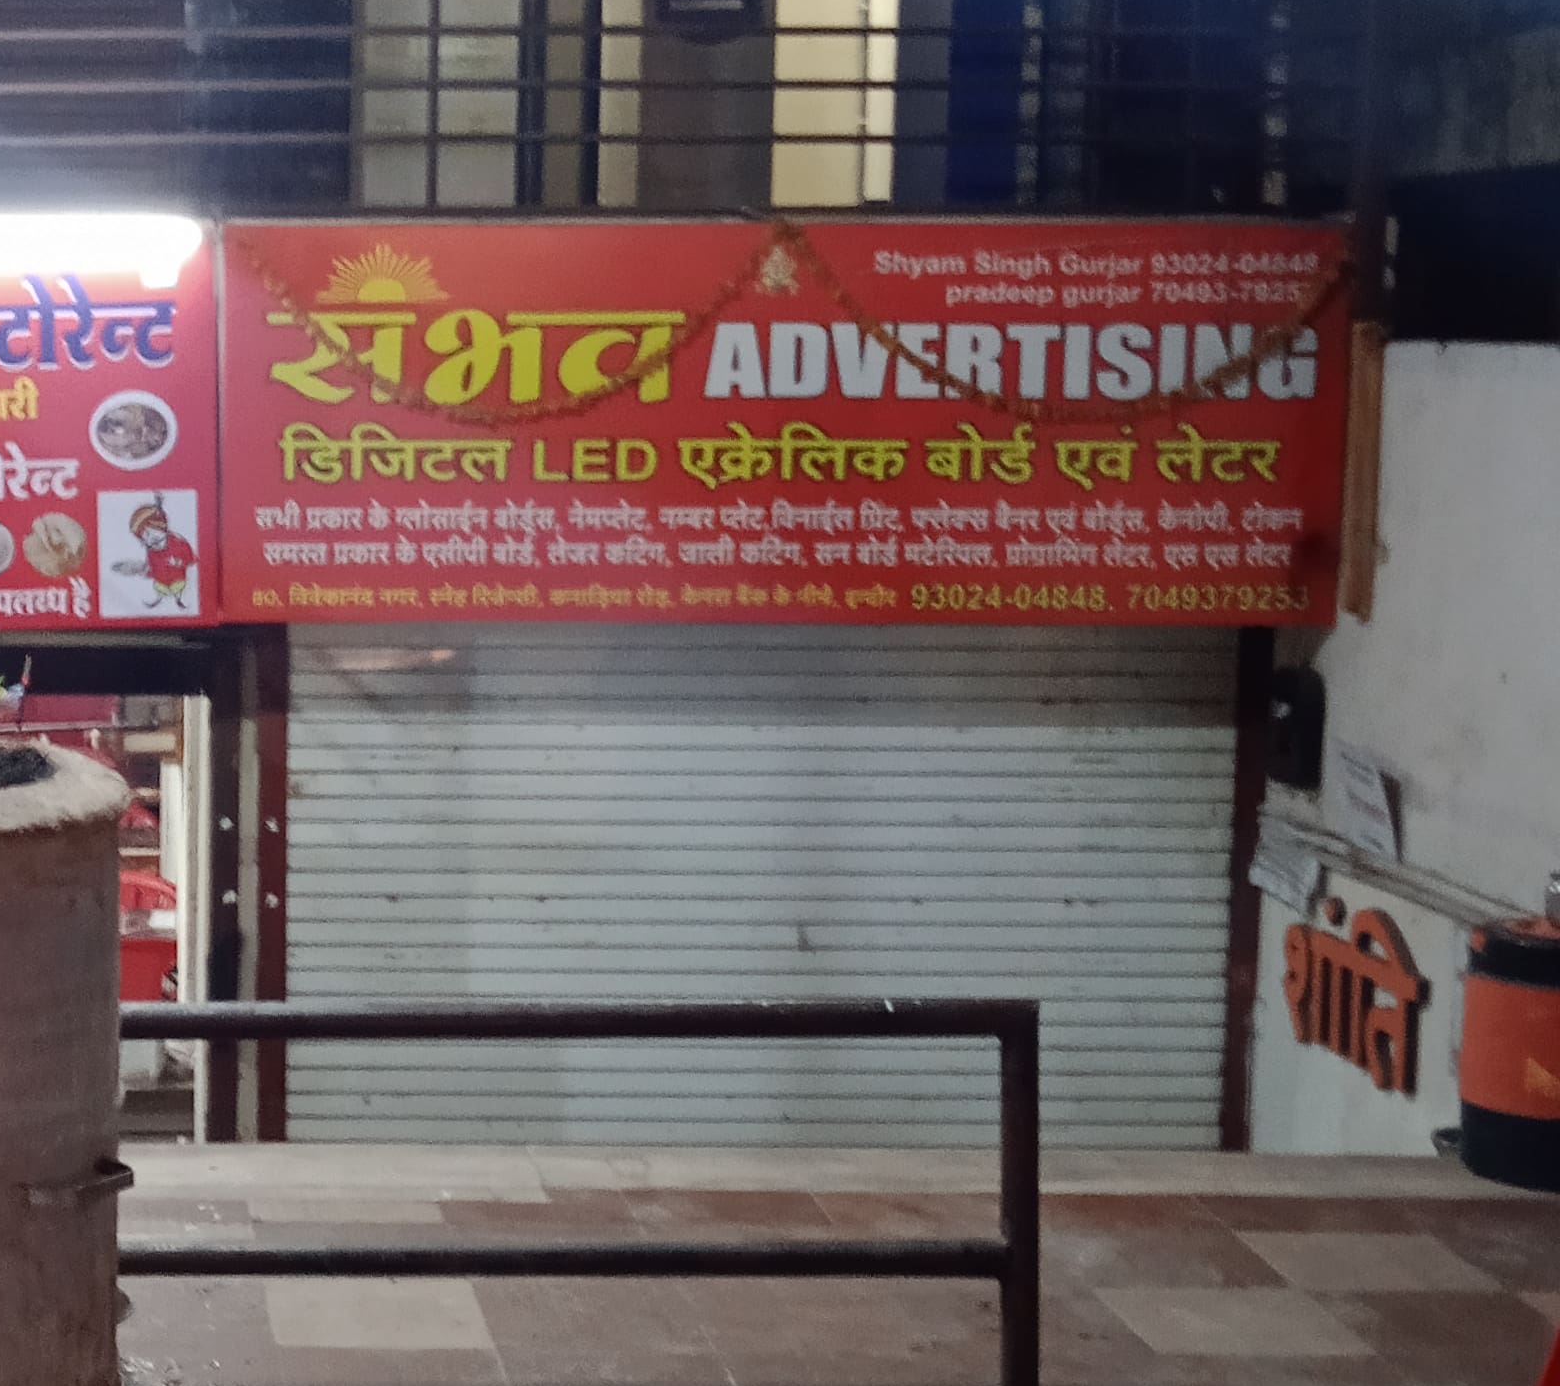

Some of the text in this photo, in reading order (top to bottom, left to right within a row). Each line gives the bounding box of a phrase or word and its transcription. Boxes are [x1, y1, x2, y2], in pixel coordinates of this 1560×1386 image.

[874, 250, 967, 279] Shyam
[973, 251, 1053, 279] Singh
[1058, 252, 1145, 279] Gurjar
[945, 281, 1055, 308] pradeep
[1062, 283, 1142, 308] gurjar
[703, 320, 1321, 401] ADVERTISING
[279, 420, 1282, 491] डिजिटल LED एक्रेलिक बोर्ड एवं लेटर
